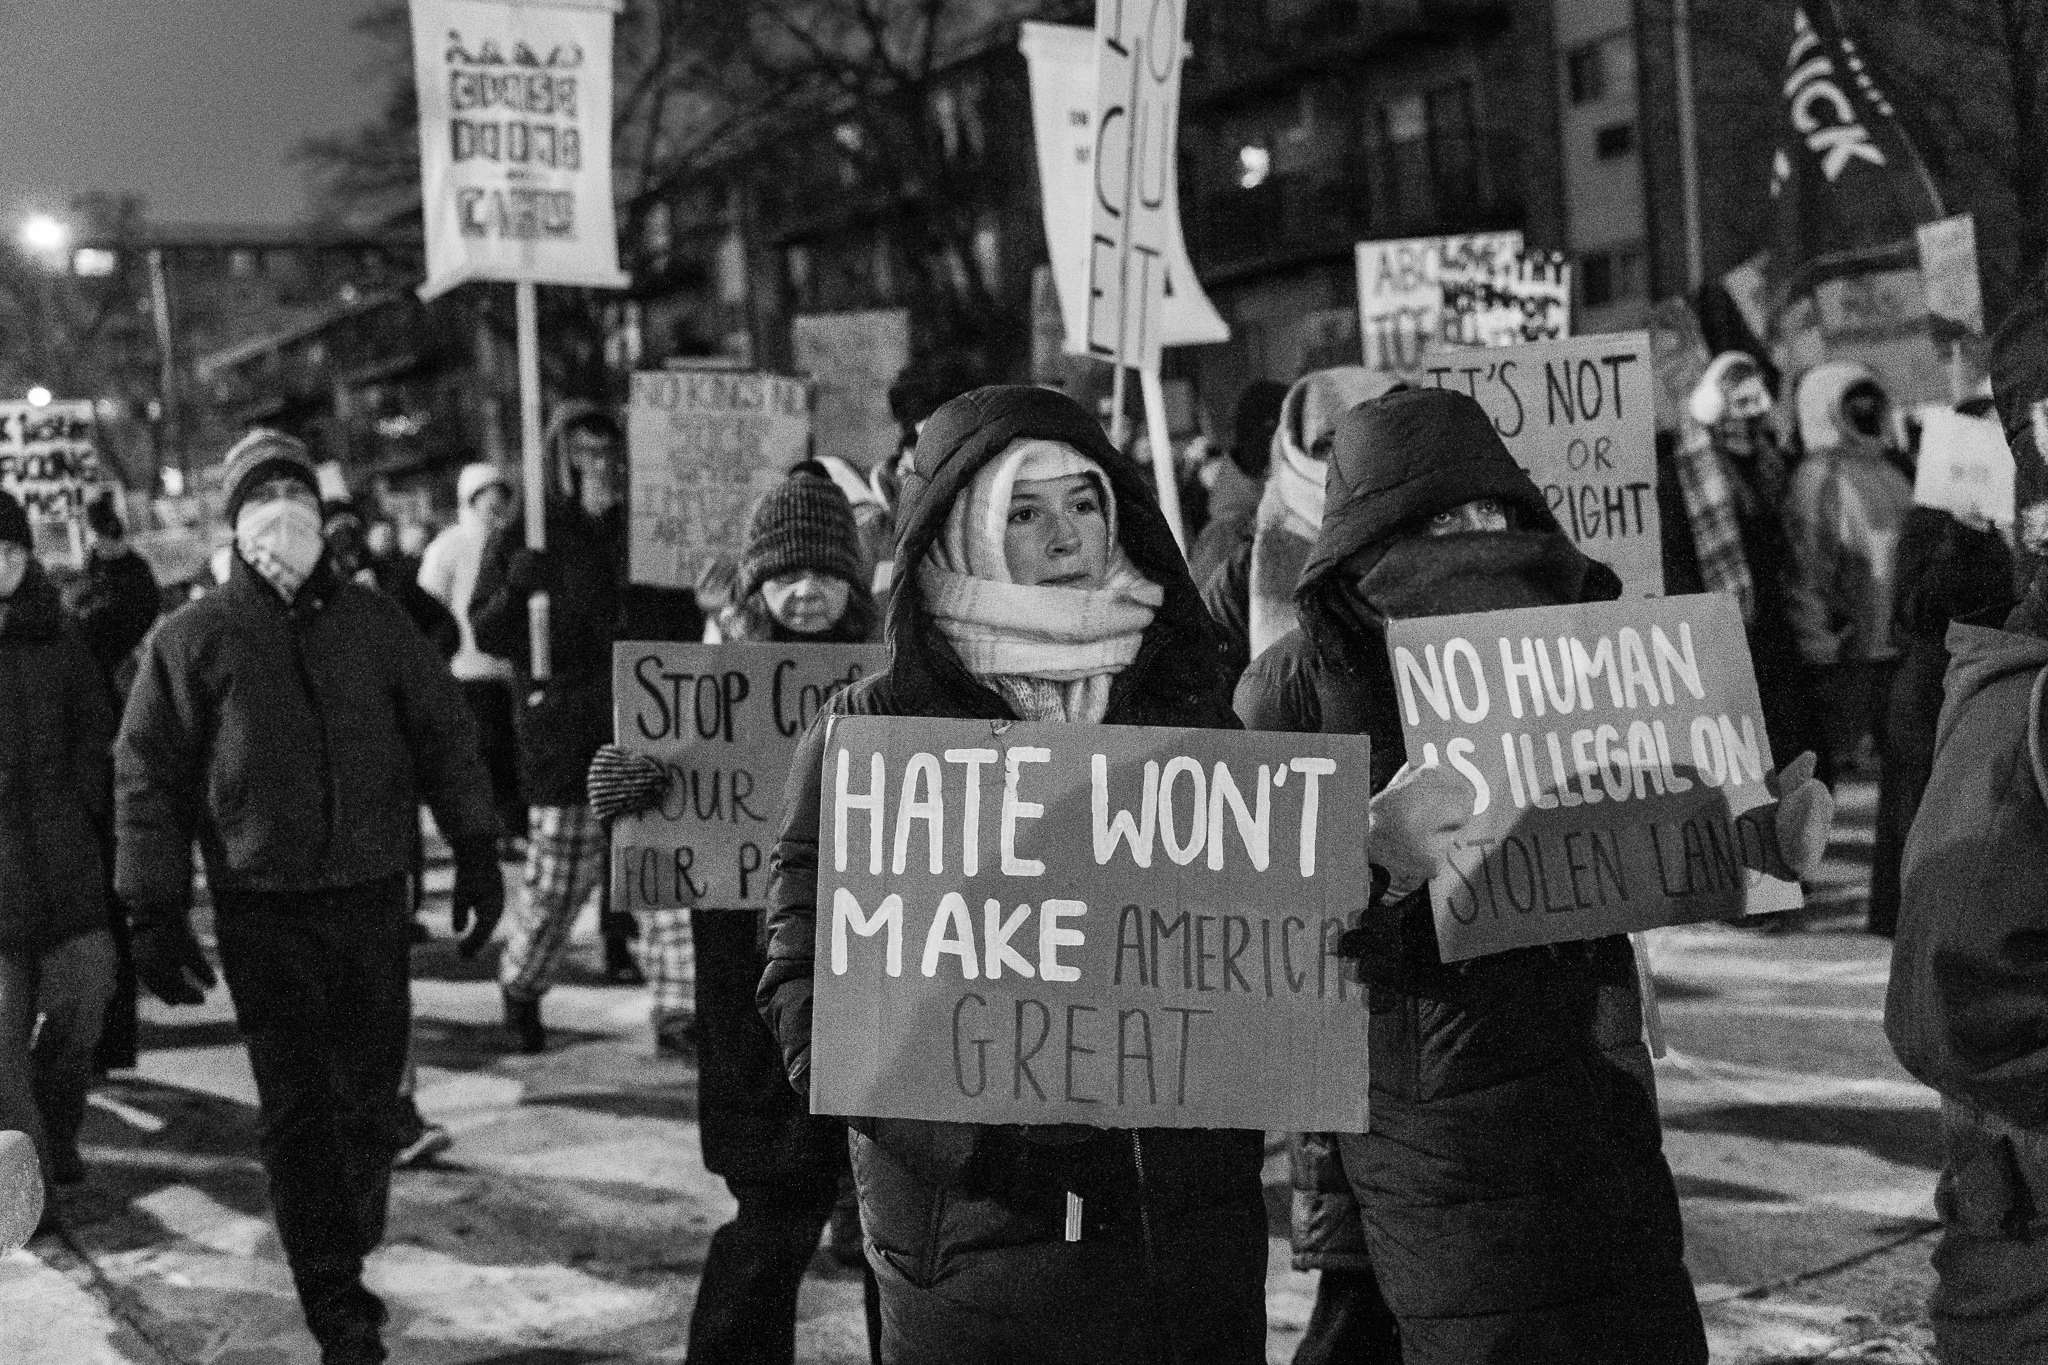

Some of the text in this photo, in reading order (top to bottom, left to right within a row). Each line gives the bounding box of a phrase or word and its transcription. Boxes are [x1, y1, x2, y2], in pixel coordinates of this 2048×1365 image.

[1546, 353, 1638, 425] NOT
[1567, 436, 1613, 473] OR
[1395, 622, 1706, 726] NO HUMAN
[638, 763, 768, 824] OUR
[834, 746, 1337, 878] HATE WON'T
[1501, 720, 1694, 810] ILLEGAL
[1690, 714, 1764, 787] ON
[1446, 814, 1768, 926] STOLEN LAND
[831, 887, 1348, 1001] MAKE AMERICA
[951, 992, 1214, 1106] GREAT
